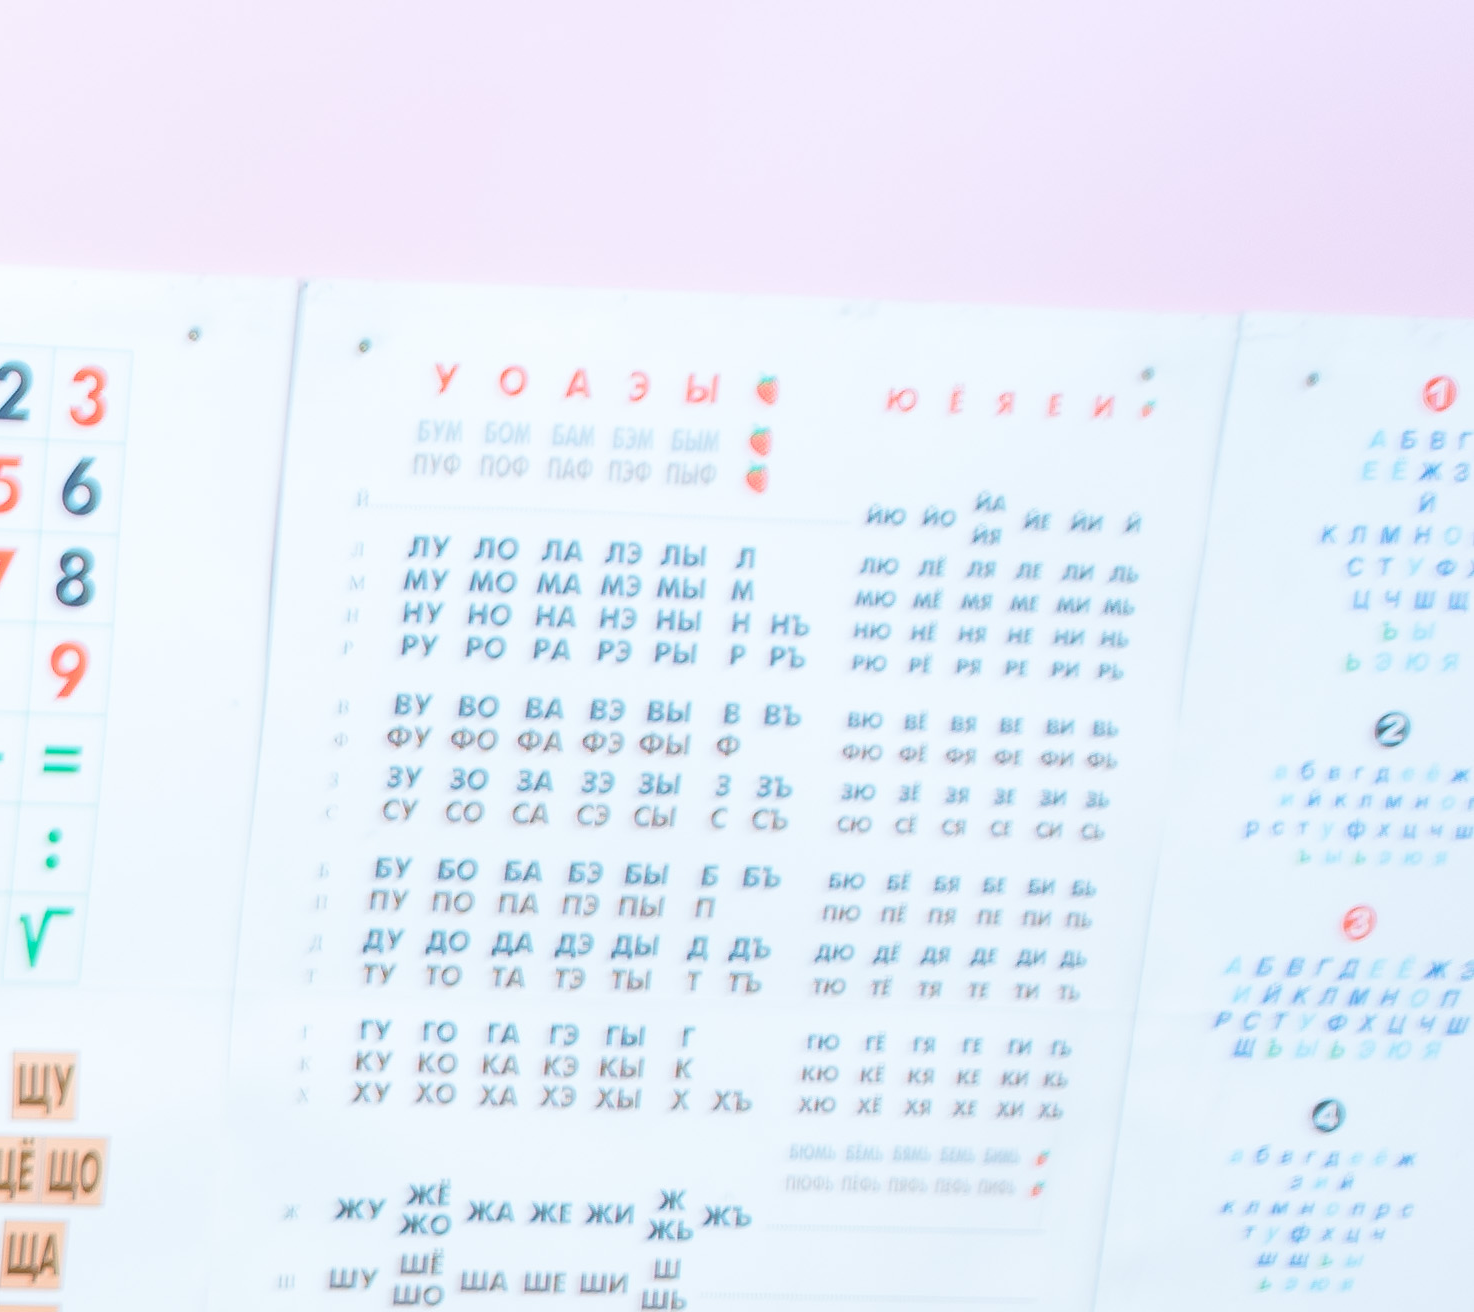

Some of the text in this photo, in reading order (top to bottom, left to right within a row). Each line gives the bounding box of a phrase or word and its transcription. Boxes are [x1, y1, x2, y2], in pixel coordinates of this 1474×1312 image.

[69, 367, 106, 427] 3
[407, 536, 756, 569] ЛУ ЛО ЛА ЛЭ ЛЫ Л
